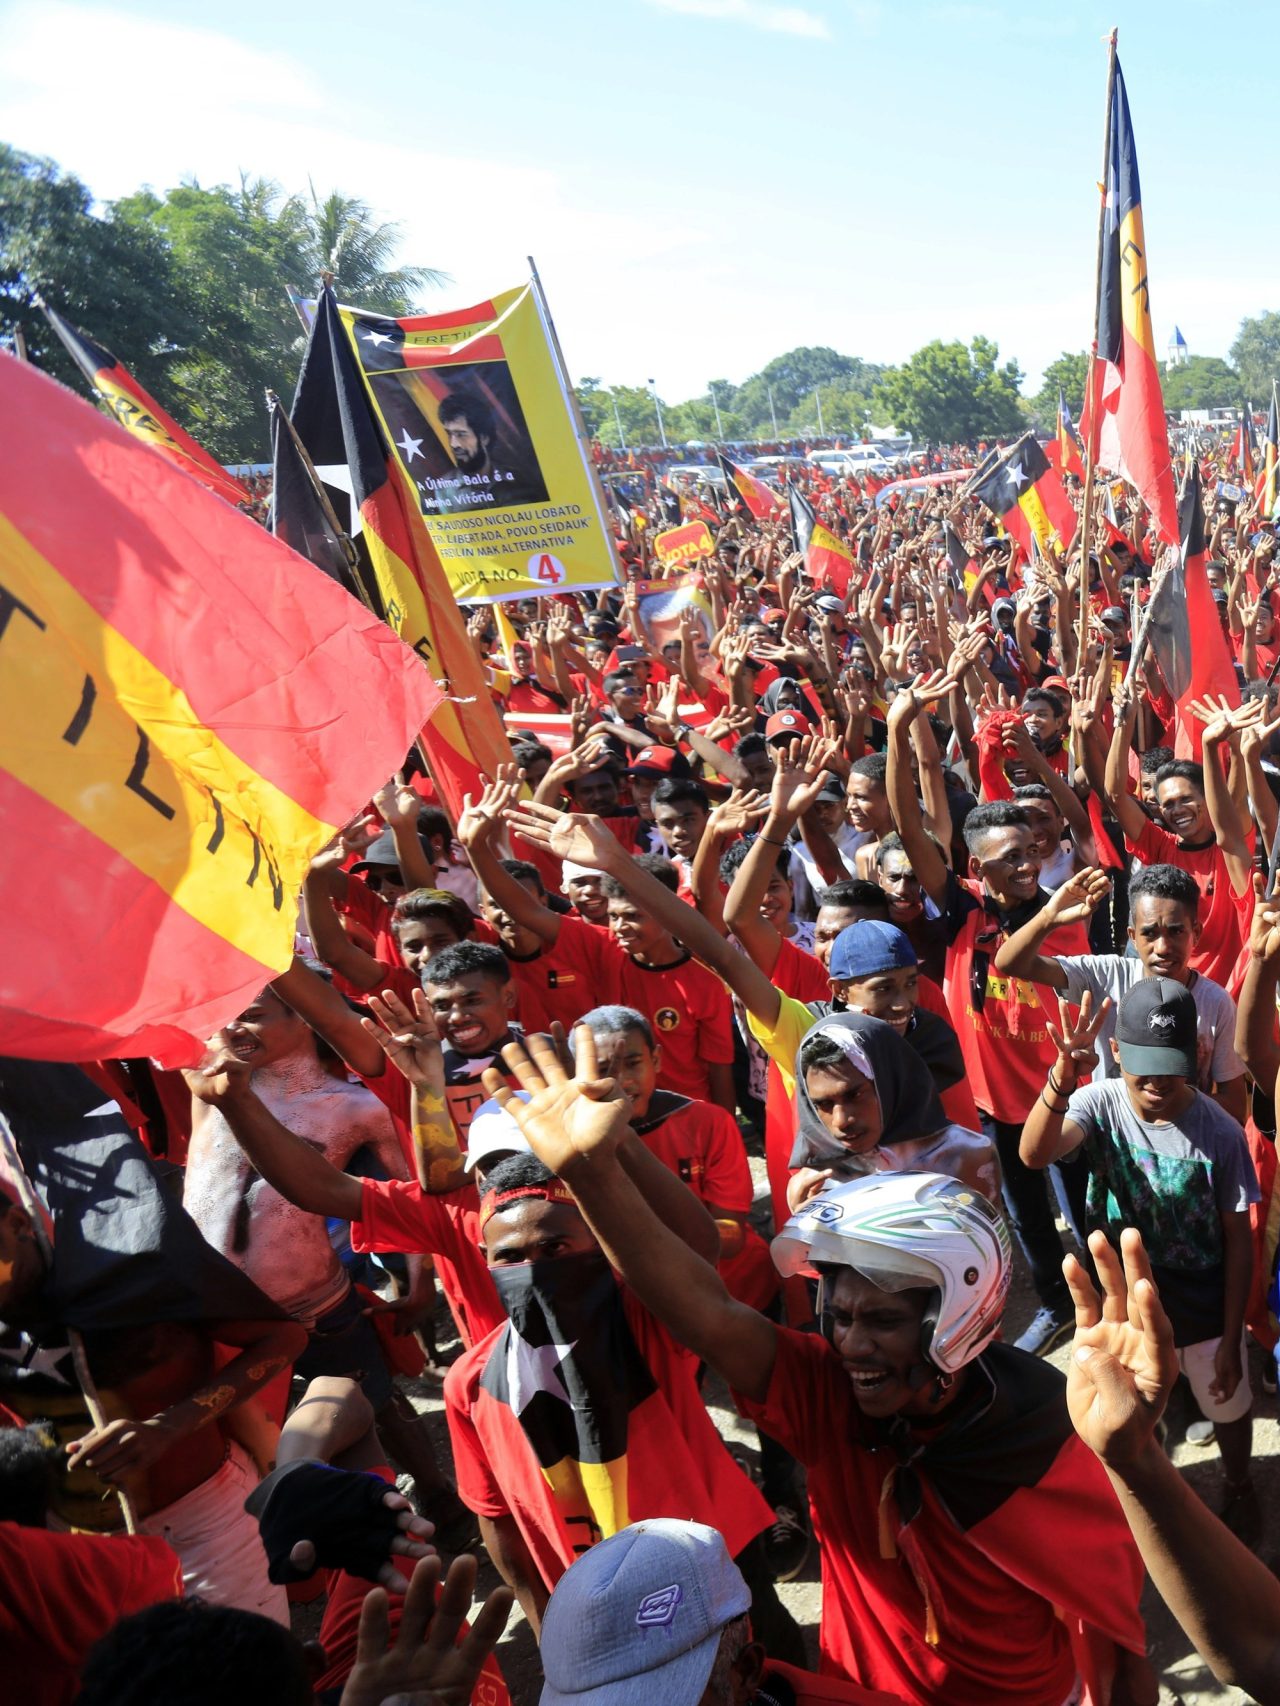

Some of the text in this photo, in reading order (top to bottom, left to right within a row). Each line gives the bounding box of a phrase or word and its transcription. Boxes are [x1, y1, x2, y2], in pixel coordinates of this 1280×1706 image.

[417, 481, 425, 491] A
[426, 477, 461, 491] Última
[463, 473, 490, 486] Bala
[505, 472, 514, 481] a
[456, 491, 495, 505] Vitória
[437, 517, 484, 531] SAUDOSO
[484, 511, 533, 526] NICOLAU
[535, 504, 581, 519] LOBATO
[507, 524, 538, 538] POVO
[477, 544, 500, 556] MAK
[502, 535, 575, 554] ALTERNATIVA
[457, 570, 489, 585] VOTA
[538, 553, 561, 584] 4
